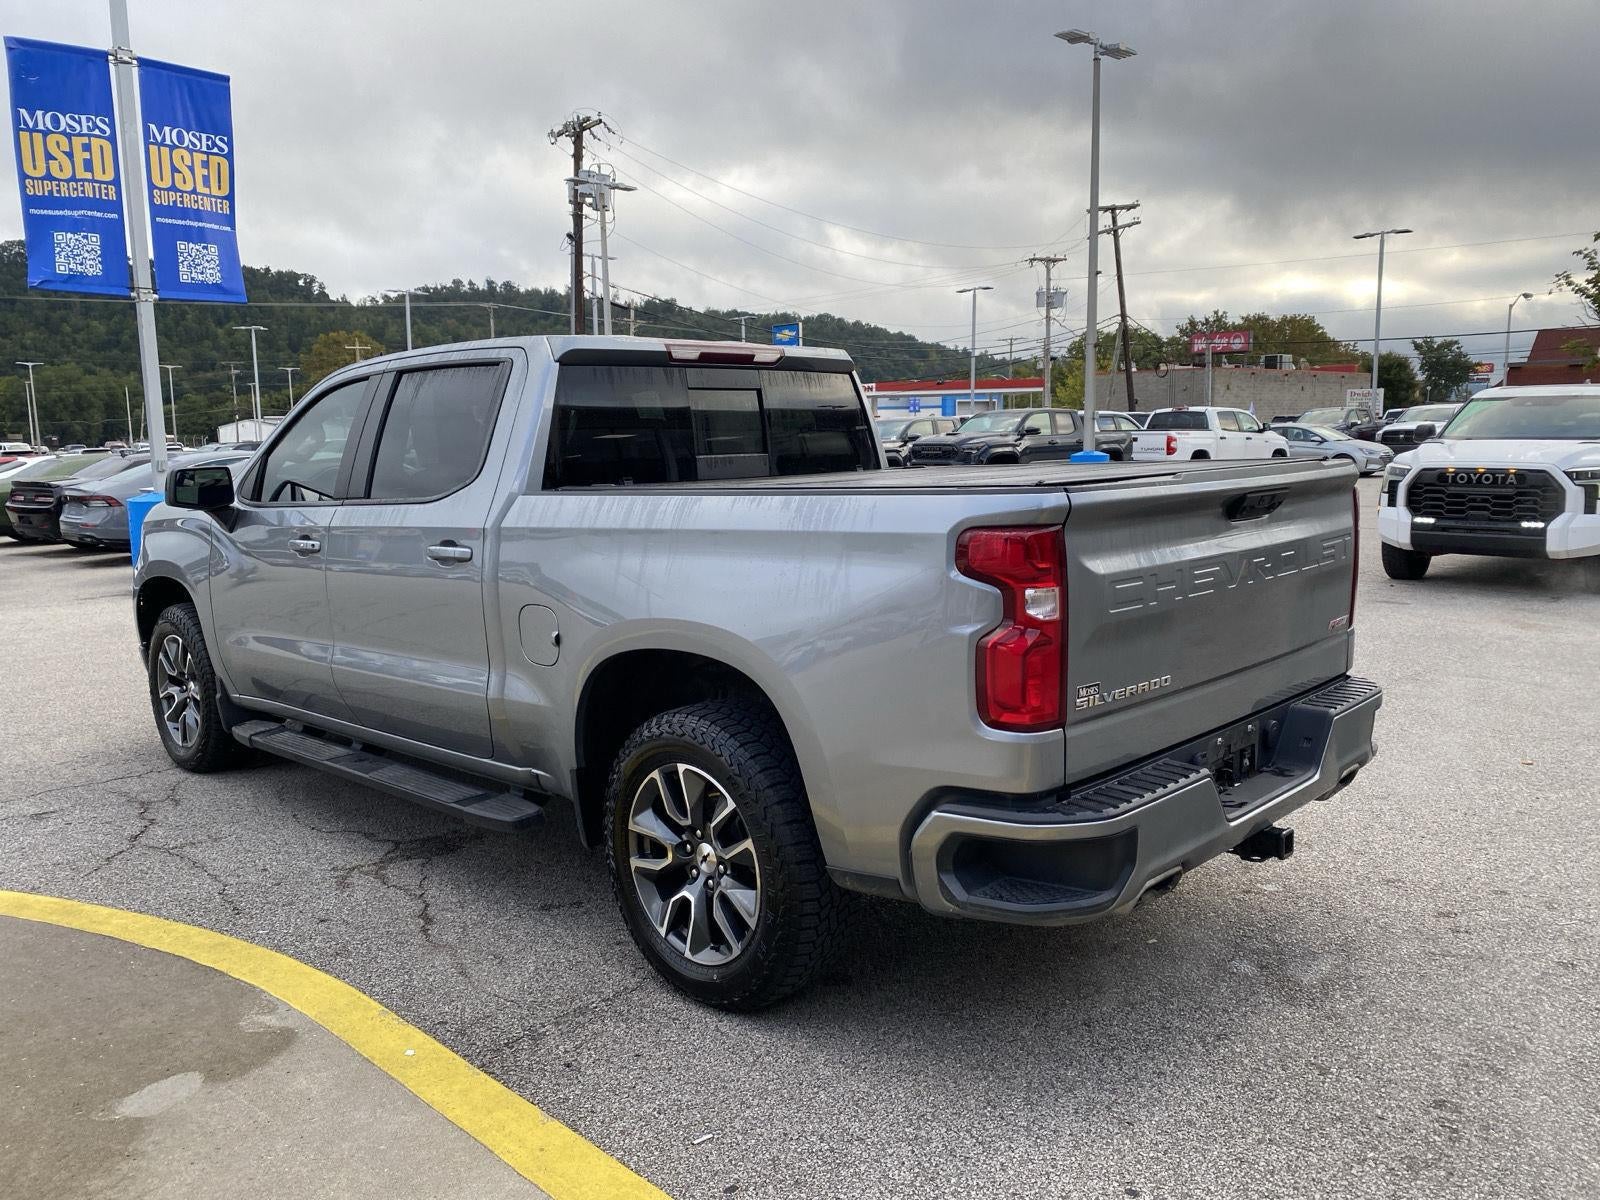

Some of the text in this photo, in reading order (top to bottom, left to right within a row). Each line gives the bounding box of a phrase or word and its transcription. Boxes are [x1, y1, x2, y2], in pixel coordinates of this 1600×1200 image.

[17, 108, 111, 136] MOSES
[148, 123, 229, 154] MOSES
[19, 131, 115, 182] USED
[149, 144, 230, 197] USED
[25, 179, 117, 201] SUPERCENTER
[153, 189, 230, 215] SUPERCENTER
[29, 208, 118, 219] mosesusedsupercenter.com
[156, 217, 231, 231] mosesusedsupercenter.com
[1194, 334, 1229, 351] Wedy's
[1446, 473, 1518, 485] TOYOTA
[1109, 535, 1351, 613] CHEVROLET
[1076, 675, 1171, 710] SILVERADO
